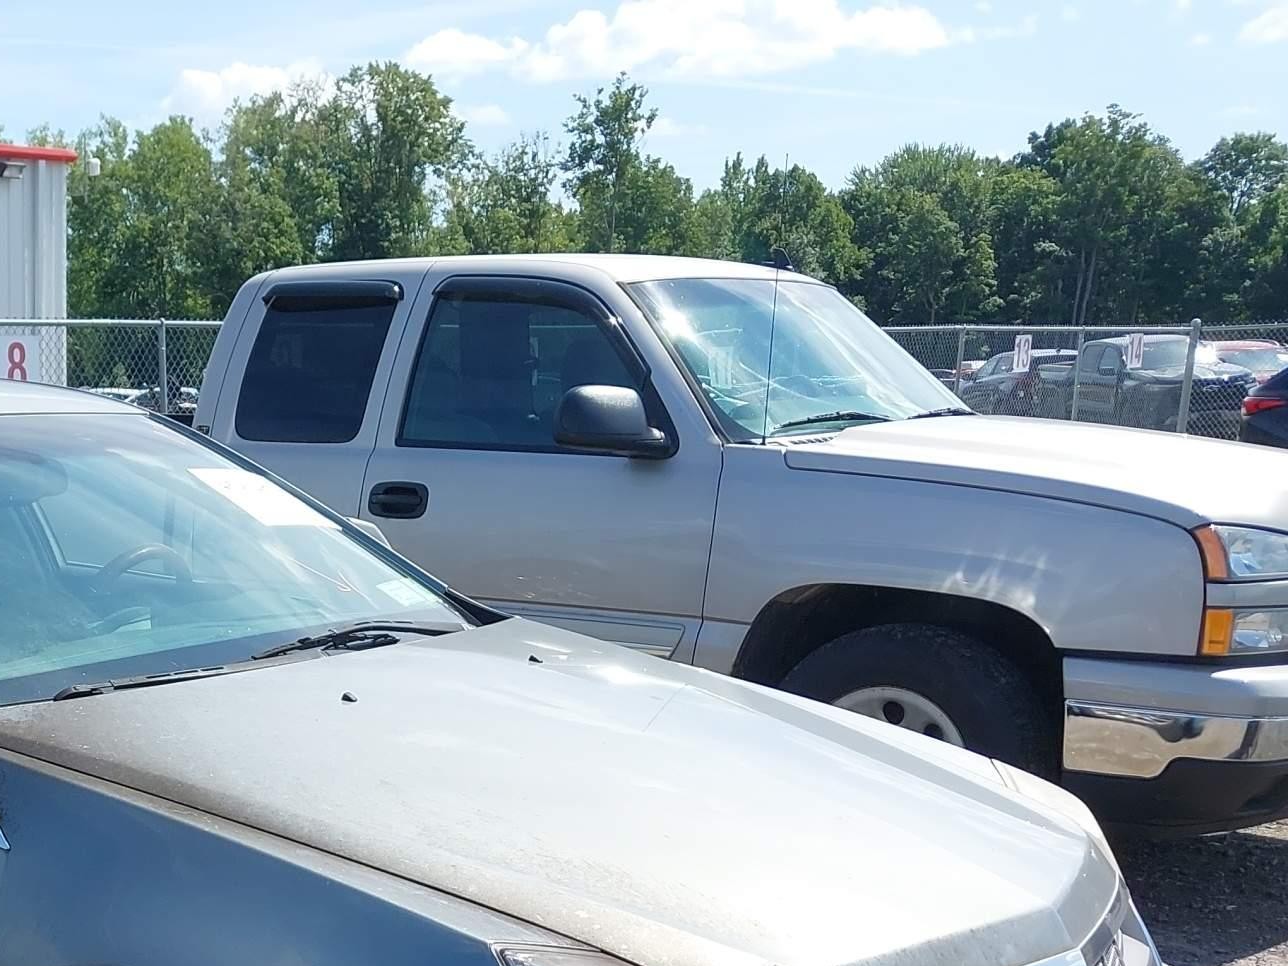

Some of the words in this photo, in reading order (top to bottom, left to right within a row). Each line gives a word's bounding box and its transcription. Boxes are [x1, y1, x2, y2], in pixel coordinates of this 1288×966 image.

[8, 342, 27, 381] 8
[1016, 338, 1029, 368] 13
[1130, 335, 1142, 364] 14
